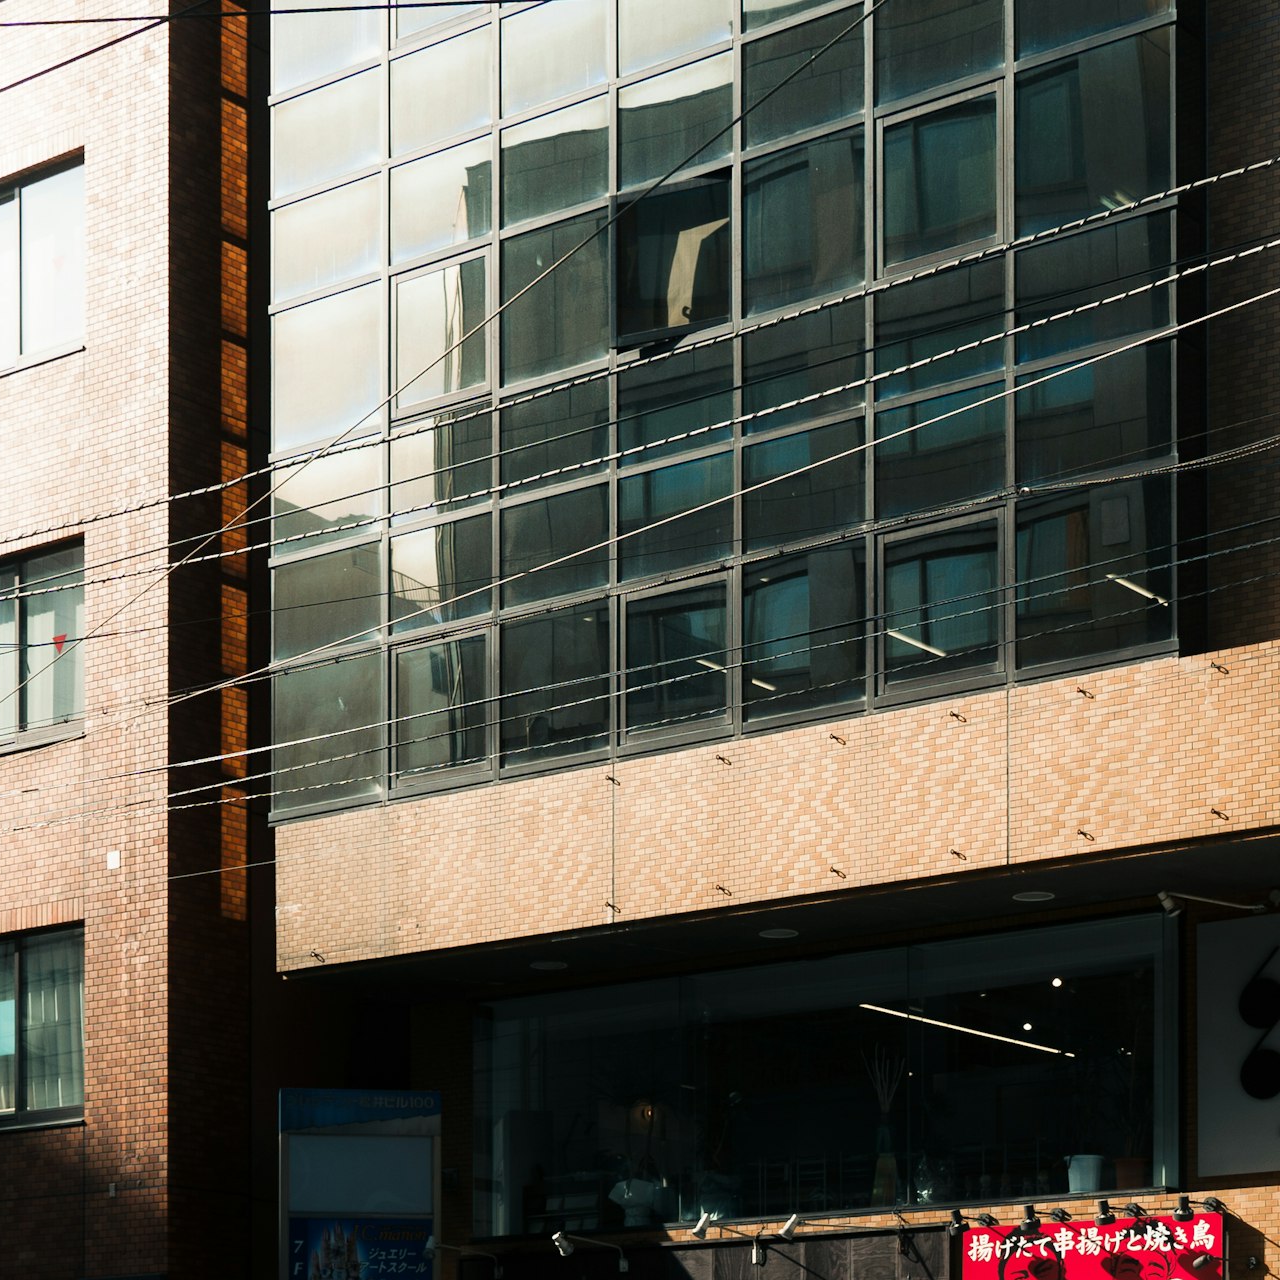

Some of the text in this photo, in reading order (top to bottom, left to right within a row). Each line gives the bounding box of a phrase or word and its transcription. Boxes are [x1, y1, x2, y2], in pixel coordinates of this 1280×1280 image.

[968, 1220, 1216, 1263] 揚げたて串揚げと焼き鳥
[368, 1247, 417, 1260] ジュエリー
[359, 1261, 428, 1274] アートスクール
